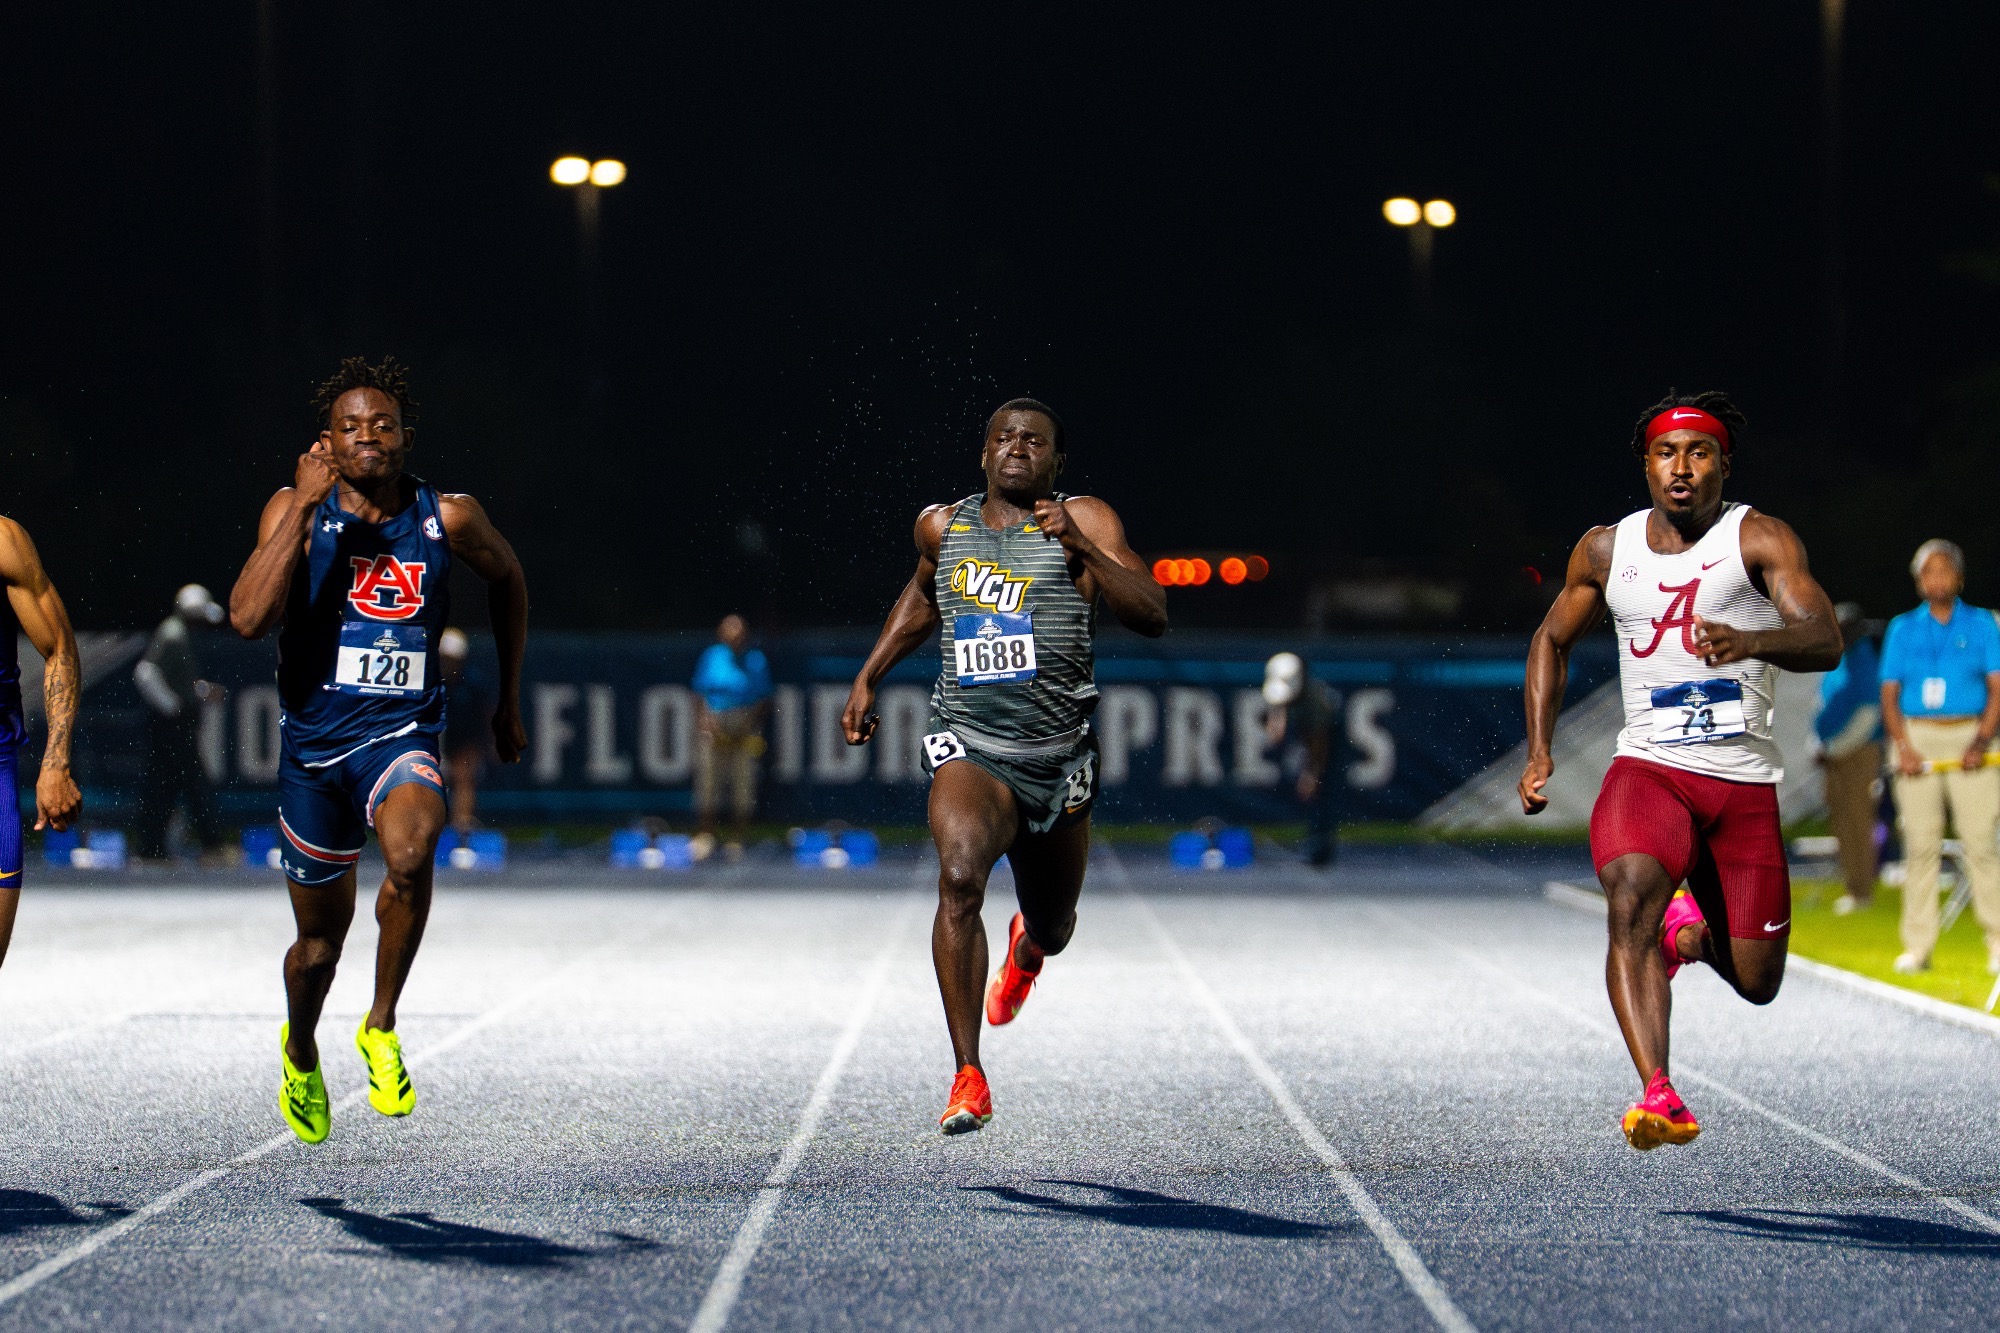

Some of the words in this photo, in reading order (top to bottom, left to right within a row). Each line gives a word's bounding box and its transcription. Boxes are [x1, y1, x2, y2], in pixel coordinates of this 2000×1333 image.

[425, 516, 443, 538] SE
[951, 557, 1034, 614] VCU
[357, 653, 410, 686] 128
[963, 640, 1027, 673] 1688
[532, 683, 937, 785] FLOIDA
[1681, 708, 1717, 735] 73
[930, 735, 957, 762] 3
[1071, 767, 1090, 803] 3
